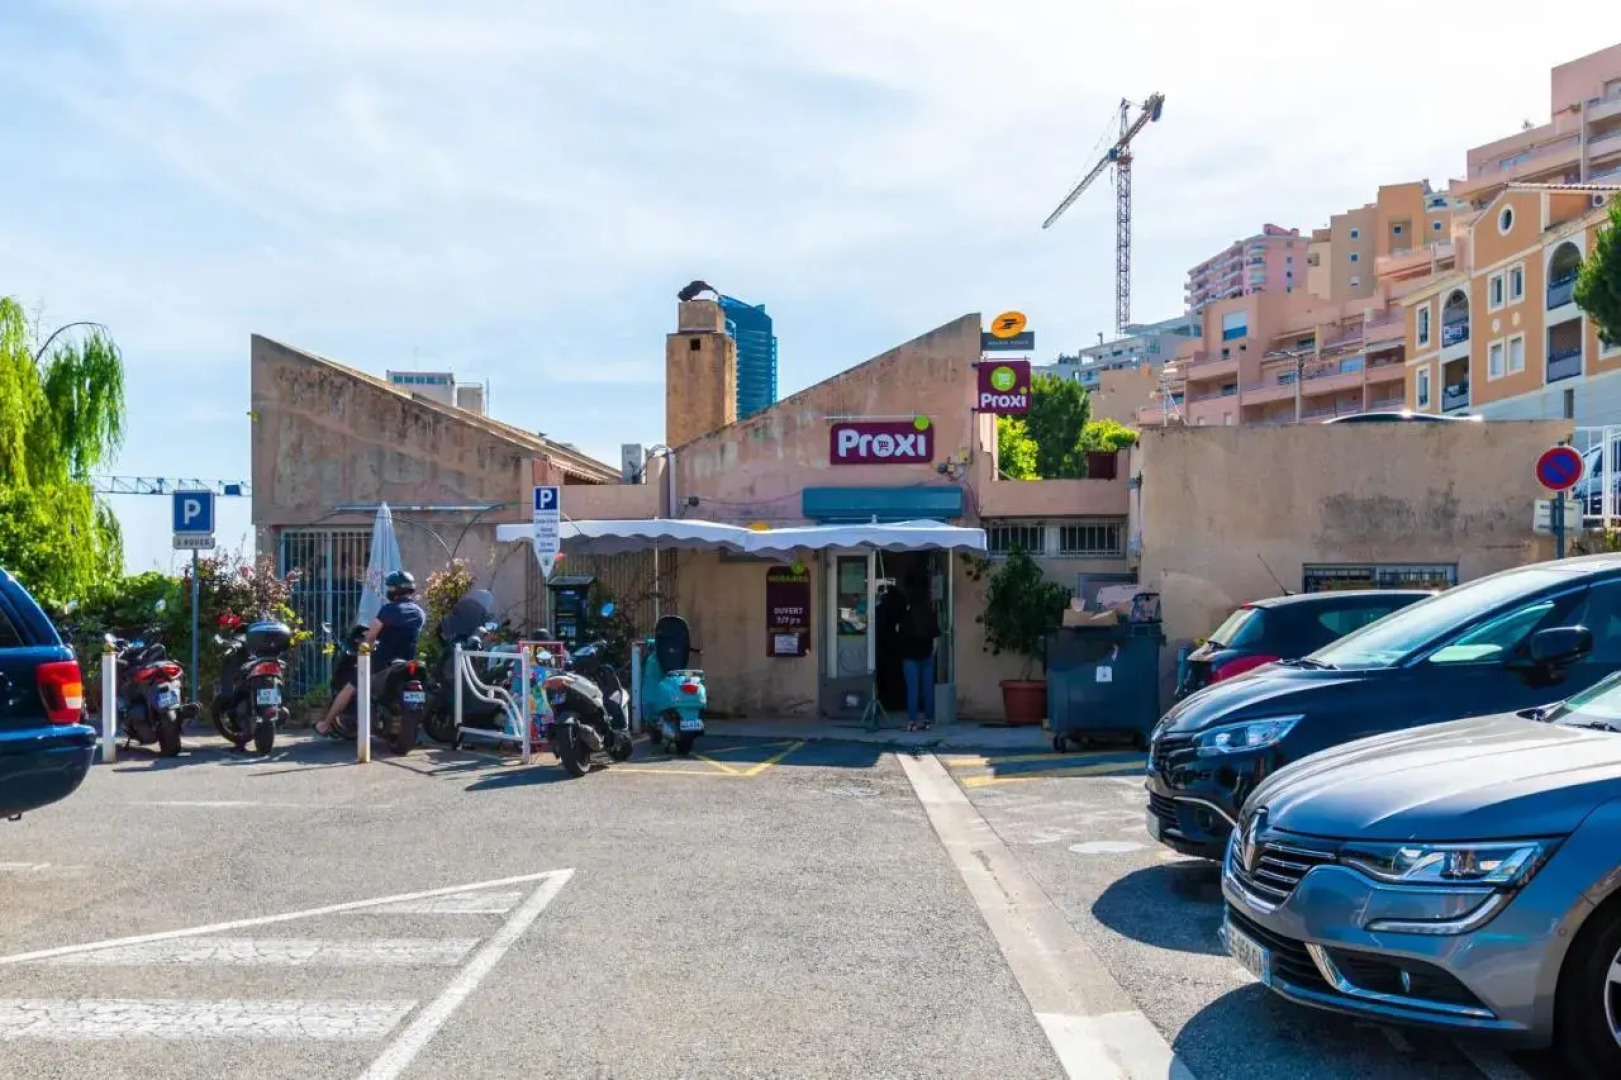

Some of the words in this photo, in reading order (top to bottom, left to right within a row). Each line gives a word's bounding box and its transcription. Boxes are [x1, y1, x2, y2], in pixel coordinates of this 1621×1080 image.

[981, 392, 1027, 408] Proxi
[838, 428, 927, 457] Proxi
[540, 489, 553, 509] P
[184, 499, 201, 525] P
[774, 607, 803, 615] OUVERT
